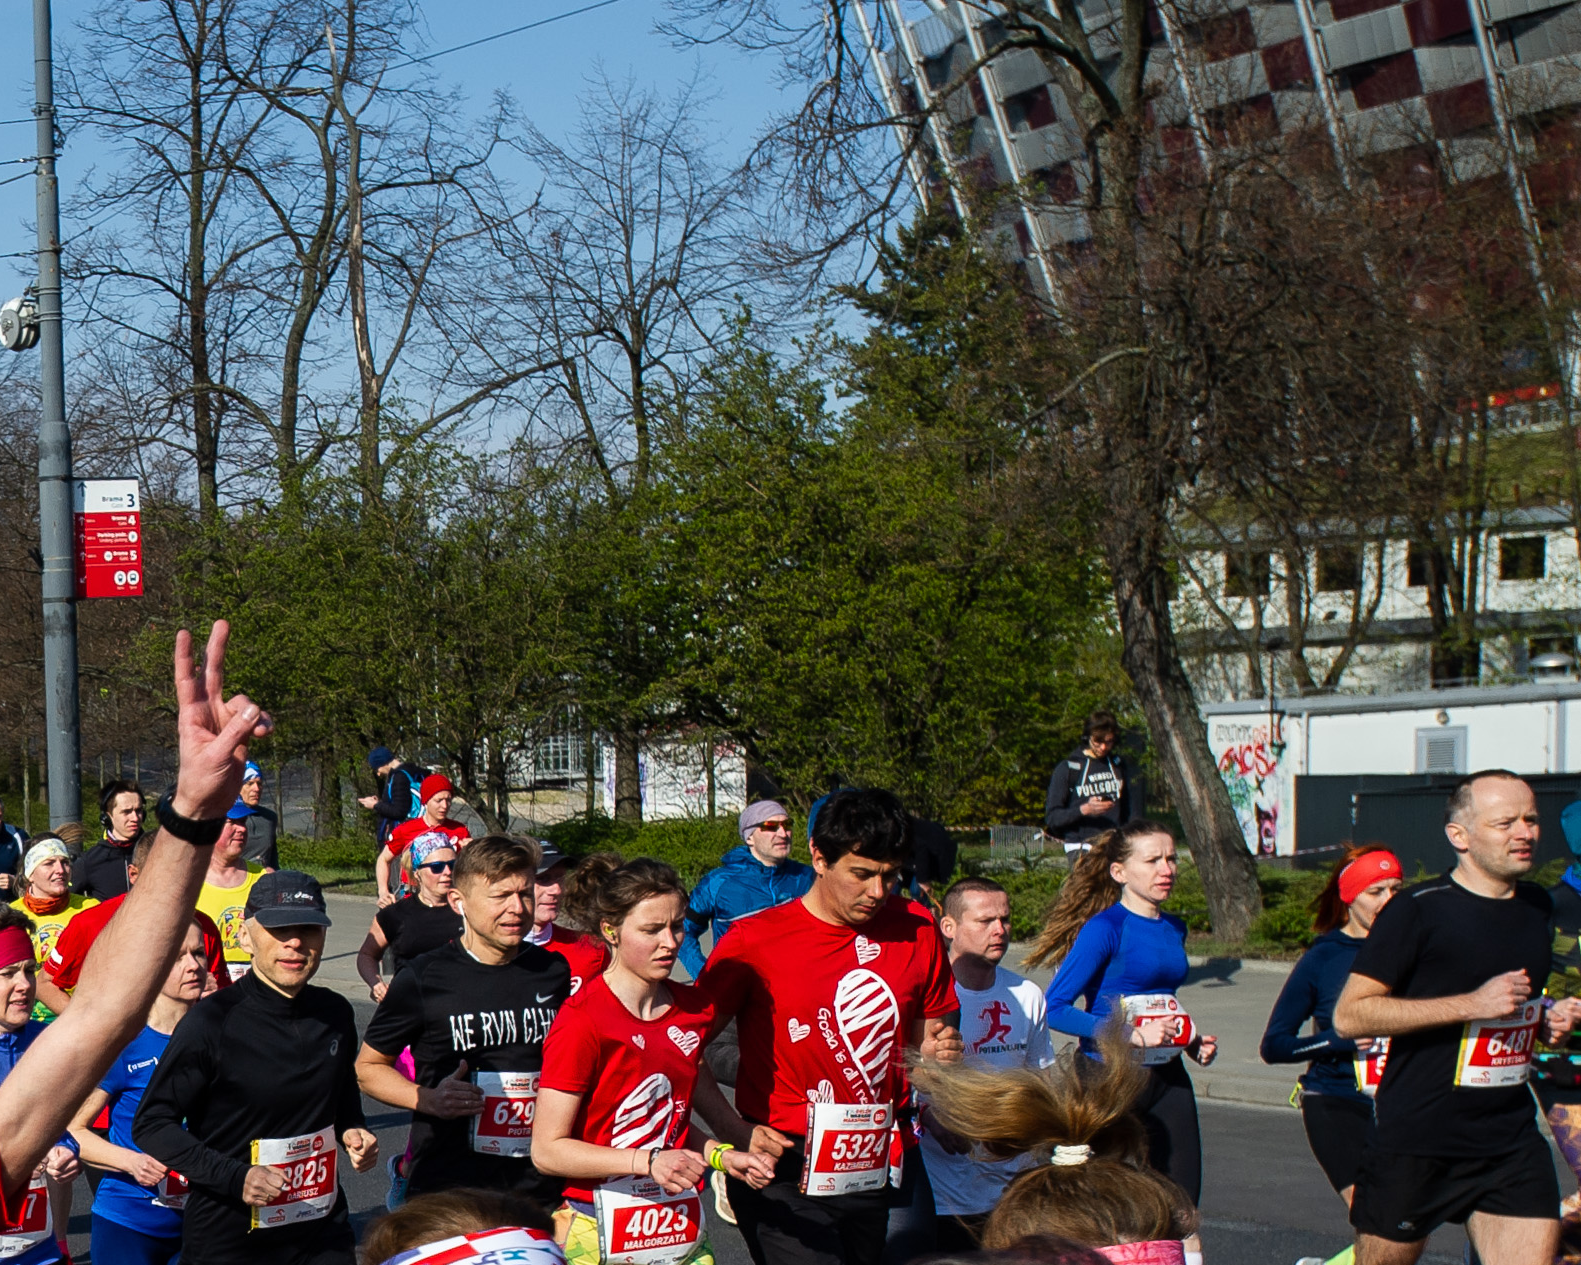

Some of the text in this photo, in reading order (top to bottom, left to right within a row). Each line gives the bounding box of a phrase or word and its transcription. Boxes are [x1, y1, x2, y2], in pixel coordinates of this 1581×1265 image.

[126, 493, 135, 508] 3
[128, 515, 136, 526] 4
[130, 550, 137, 561] 5
[449, 1013, 476, 1051] WE
[1487, 1027, 1534, 1056] 6481
[494, 1101, 535, 1126] 629
[831, 1132, 887, 1160] 5324
[281, 1157, 328, 1191] 2825
[625, 1204, 689, 1238] 4023
[623, 1233, 687, 1251] MAŁGORZATA
